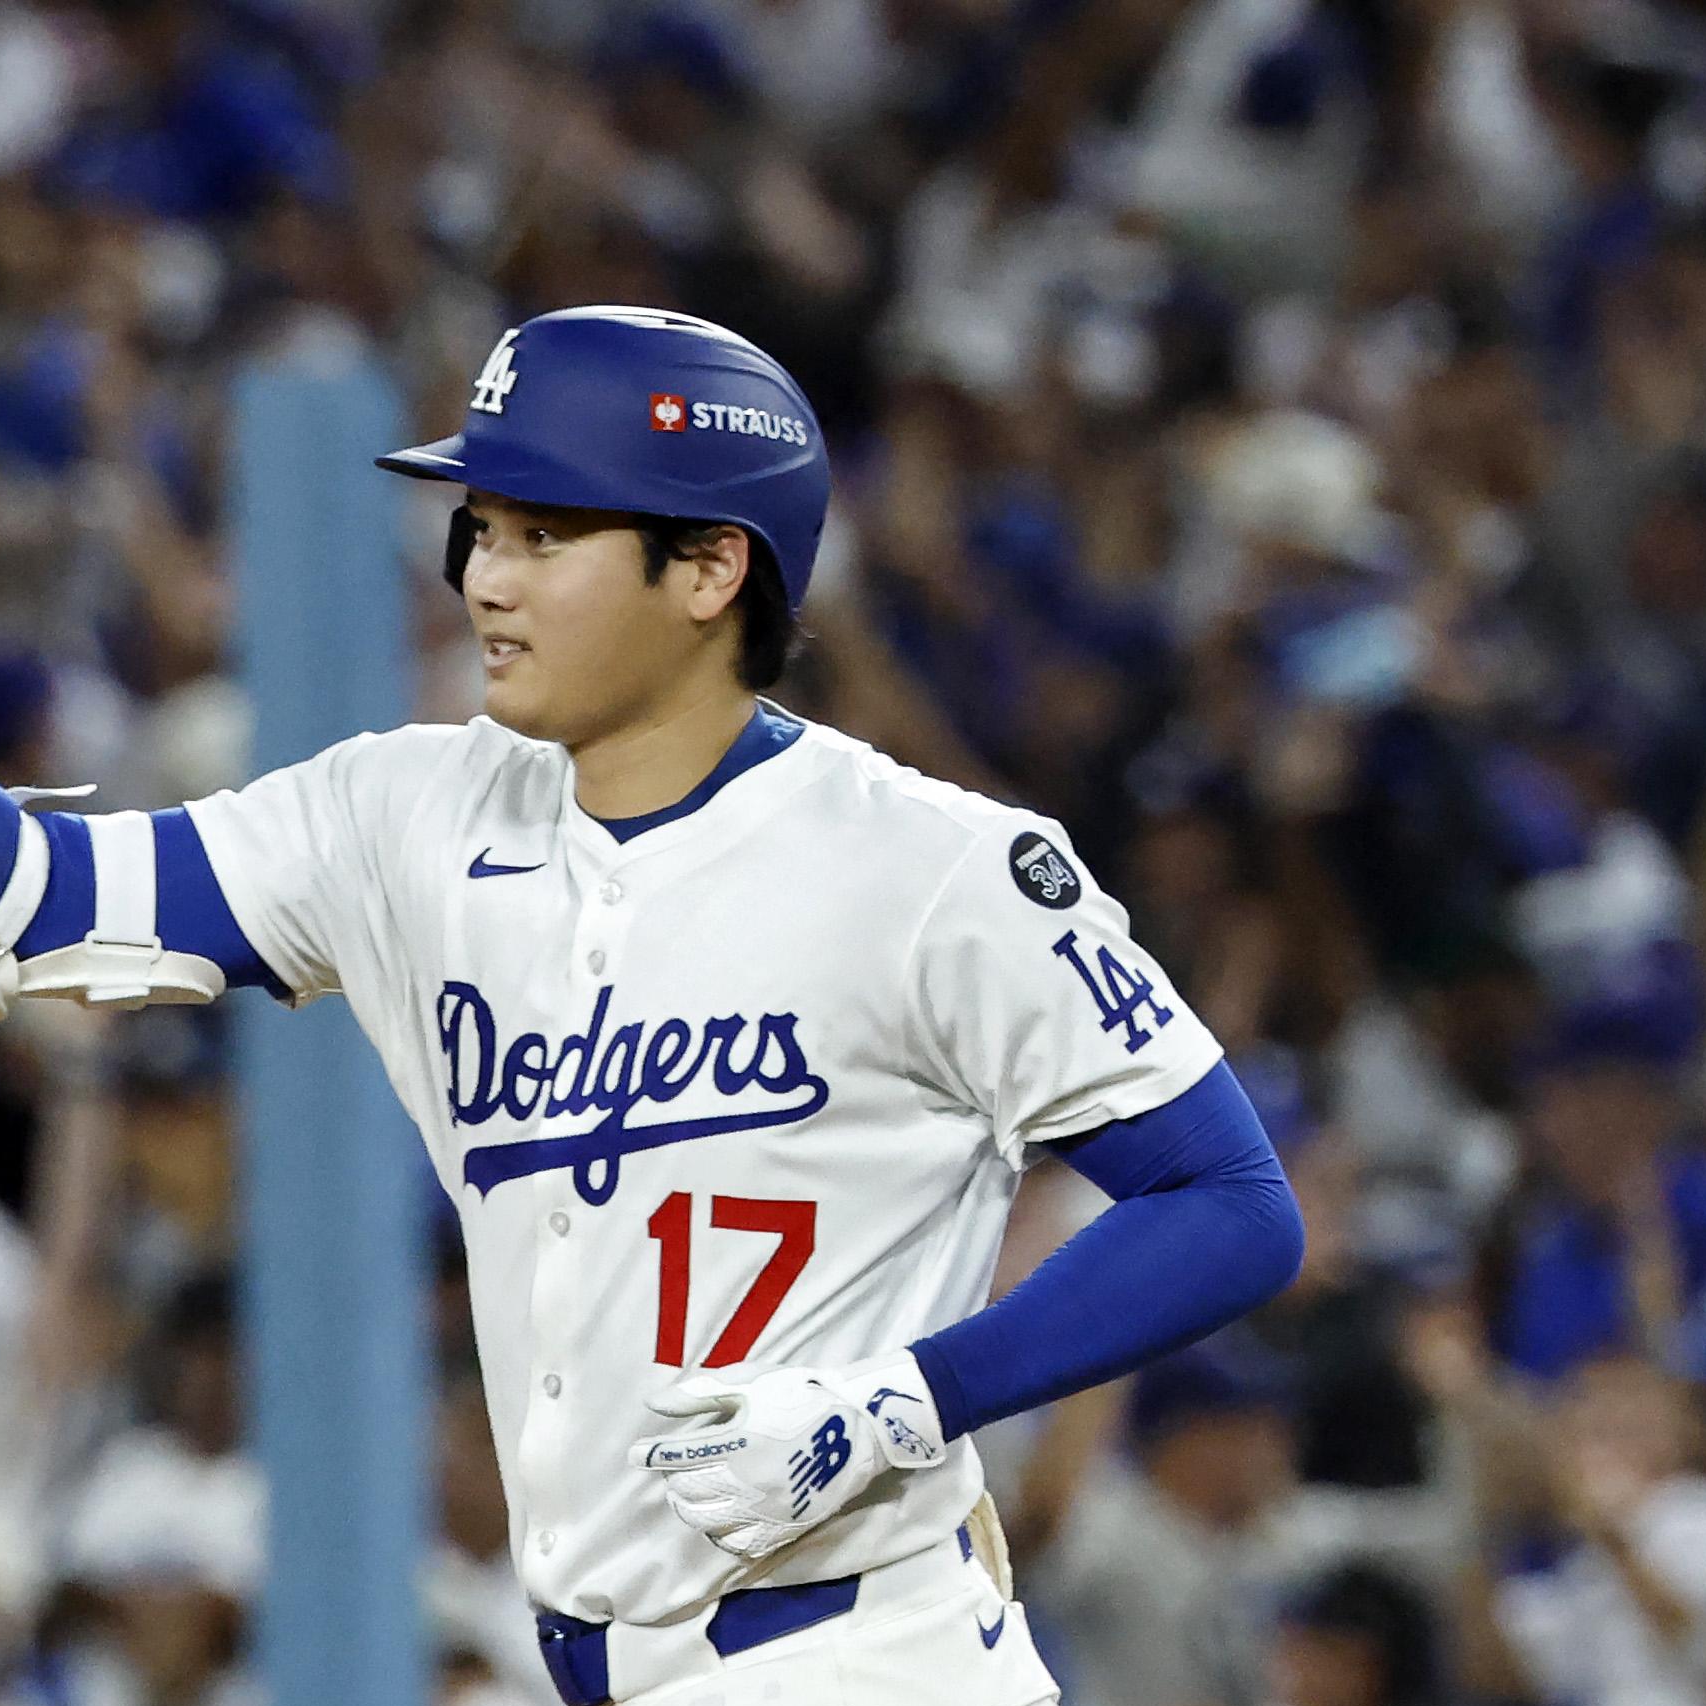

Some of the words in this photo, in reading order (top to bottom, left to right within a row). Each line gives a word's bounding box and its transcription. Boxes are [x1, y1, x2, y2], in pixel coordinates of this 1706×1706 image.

[470, 327, 521, 415] LA
[692, 402, 808, 446] STRAUSS
[1028, 853, 1076, 900] 34
[1051, 928, 1174, 1055] LA
[436, 978, 830, 1207] Dodgers
[647, 1191, 818, 1369] 17
[686, 1437, 747, 1459] balance
